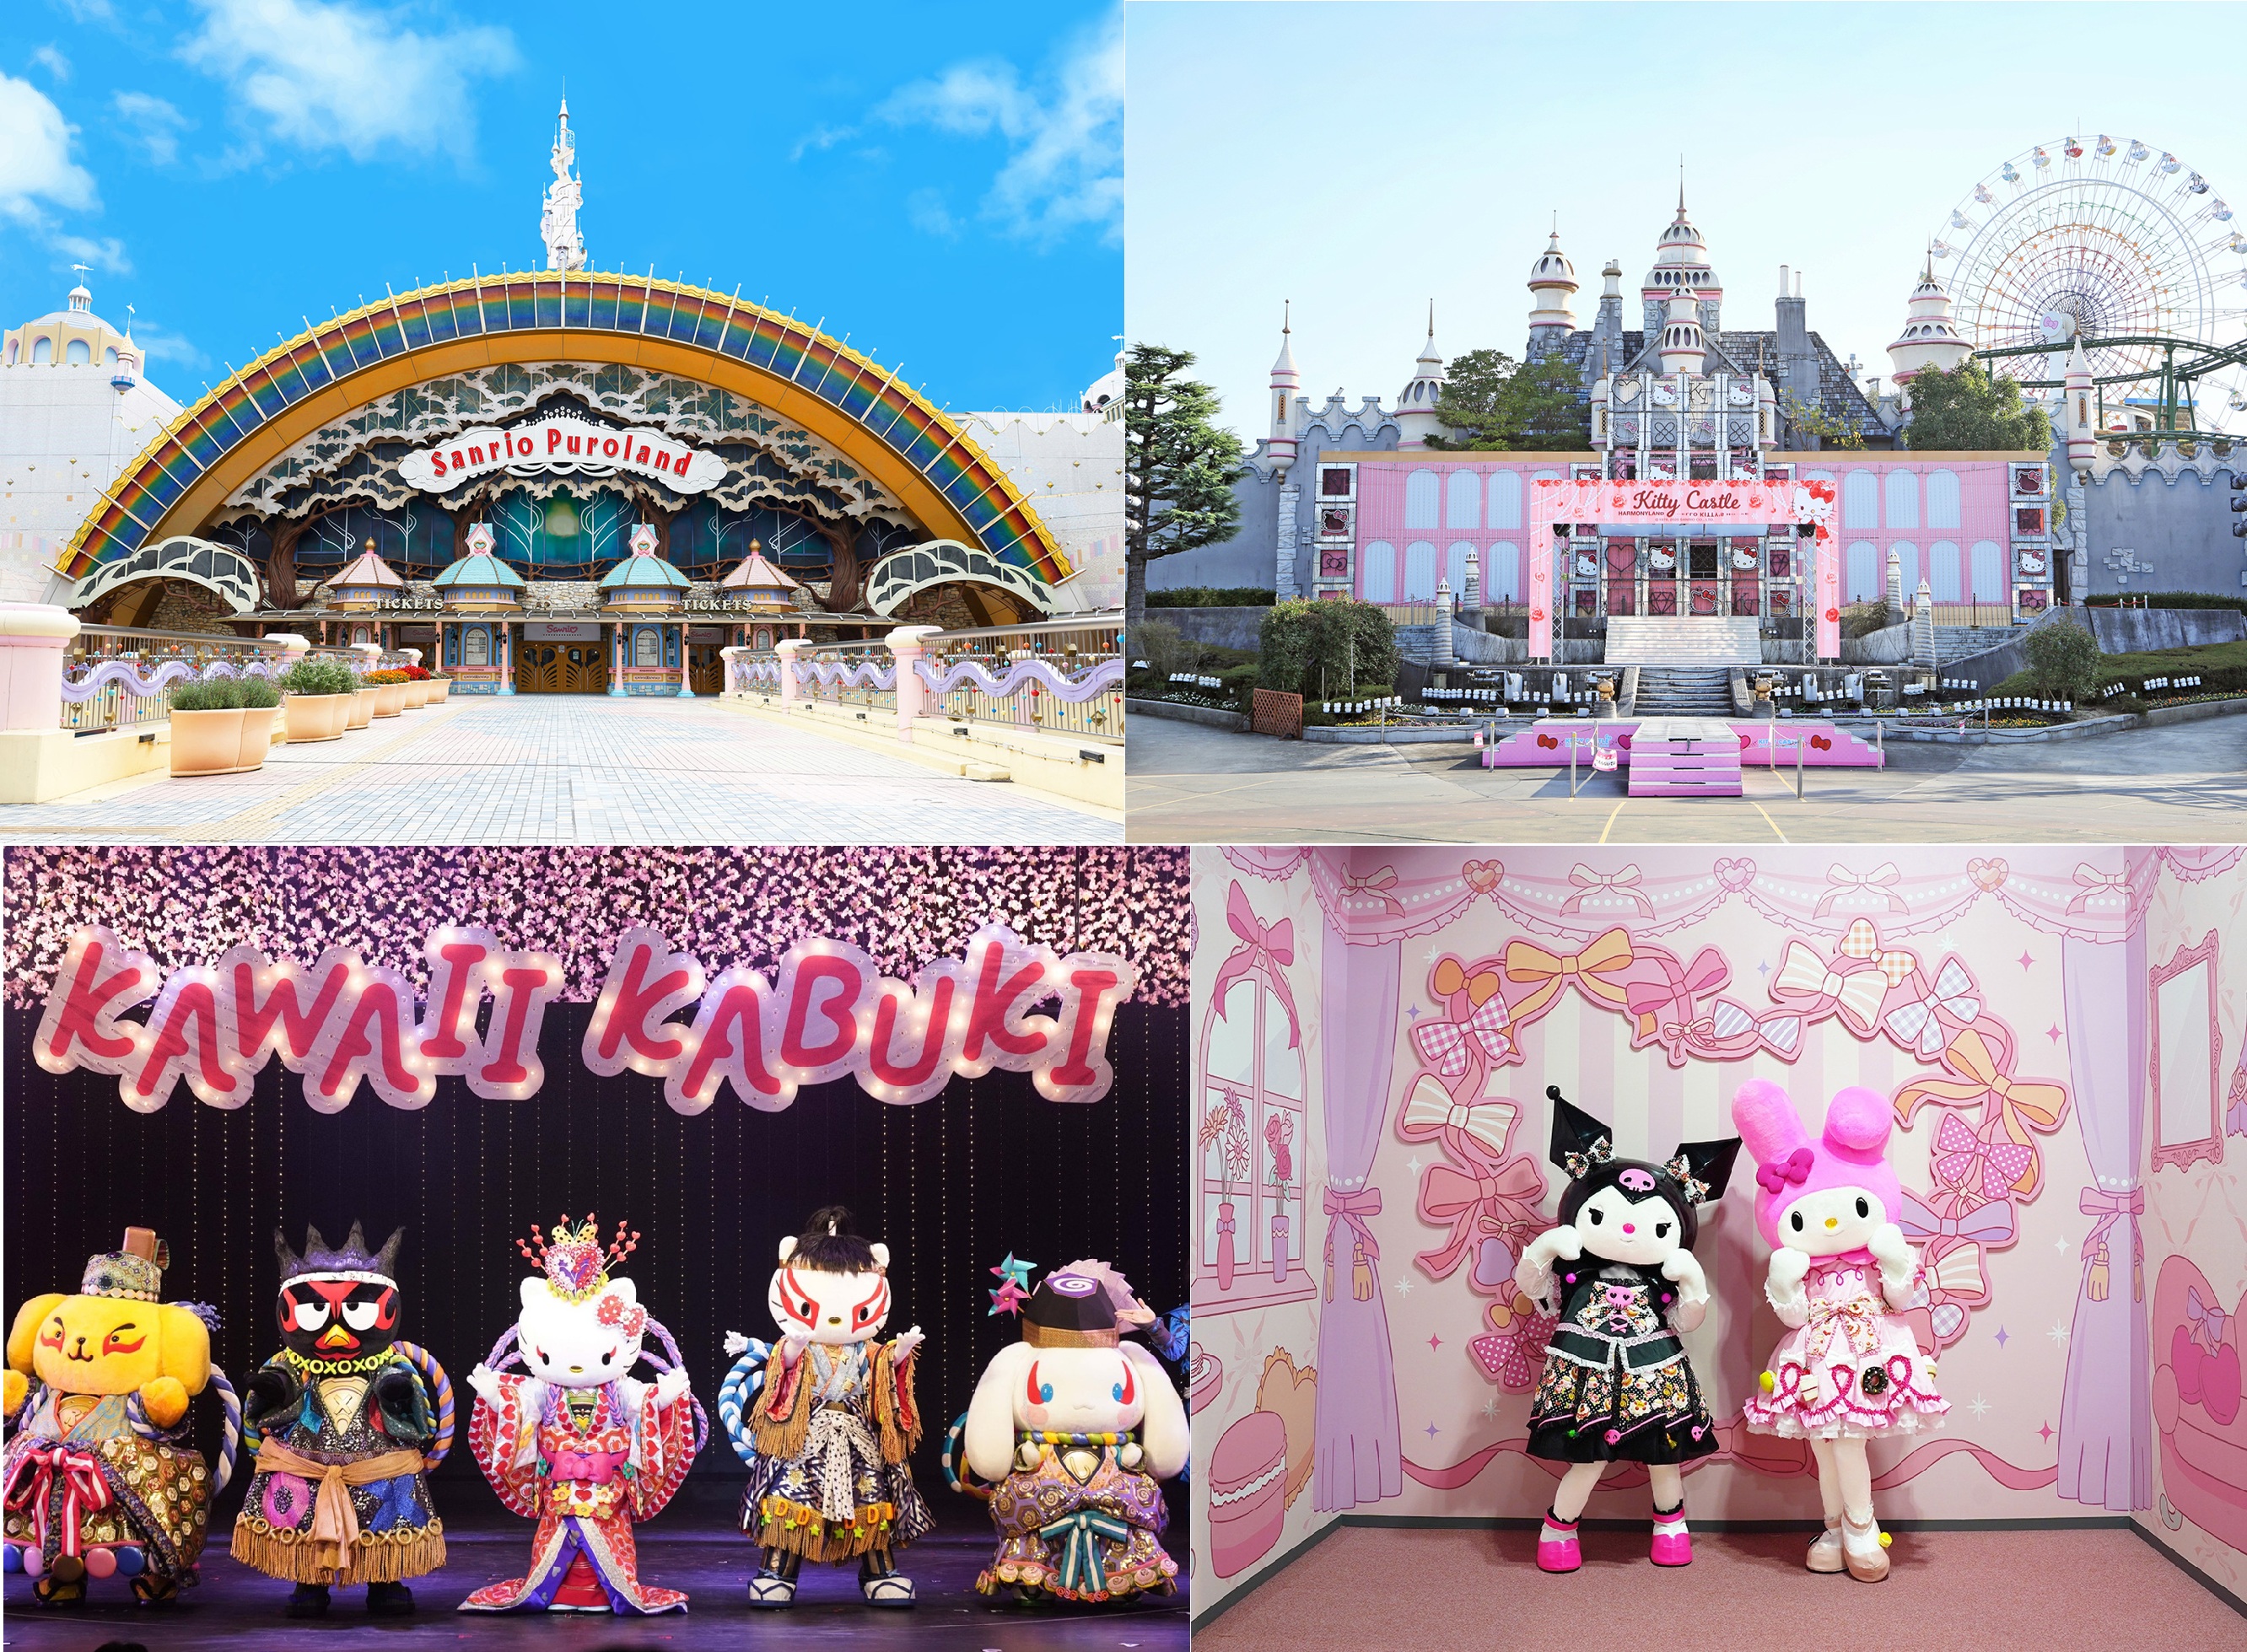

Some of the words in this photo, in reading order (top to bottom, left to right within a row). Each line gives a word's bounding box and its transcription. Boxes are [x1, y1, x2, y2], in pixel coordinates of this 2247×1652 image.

[430, 431, 534, 477] Sanrio
[547, 428, 693, 477] Puroland
[1633, 490, 1680, 517] Kitty
[1686, 490, 1741, 509] Castle
[374, 598, 445, 610] TICKETS
[682, 599, 752, 611] TICKETS
[48, 940, 548, 1097] KAWAII
[597, 940, 1118, 1099] KABUKI
